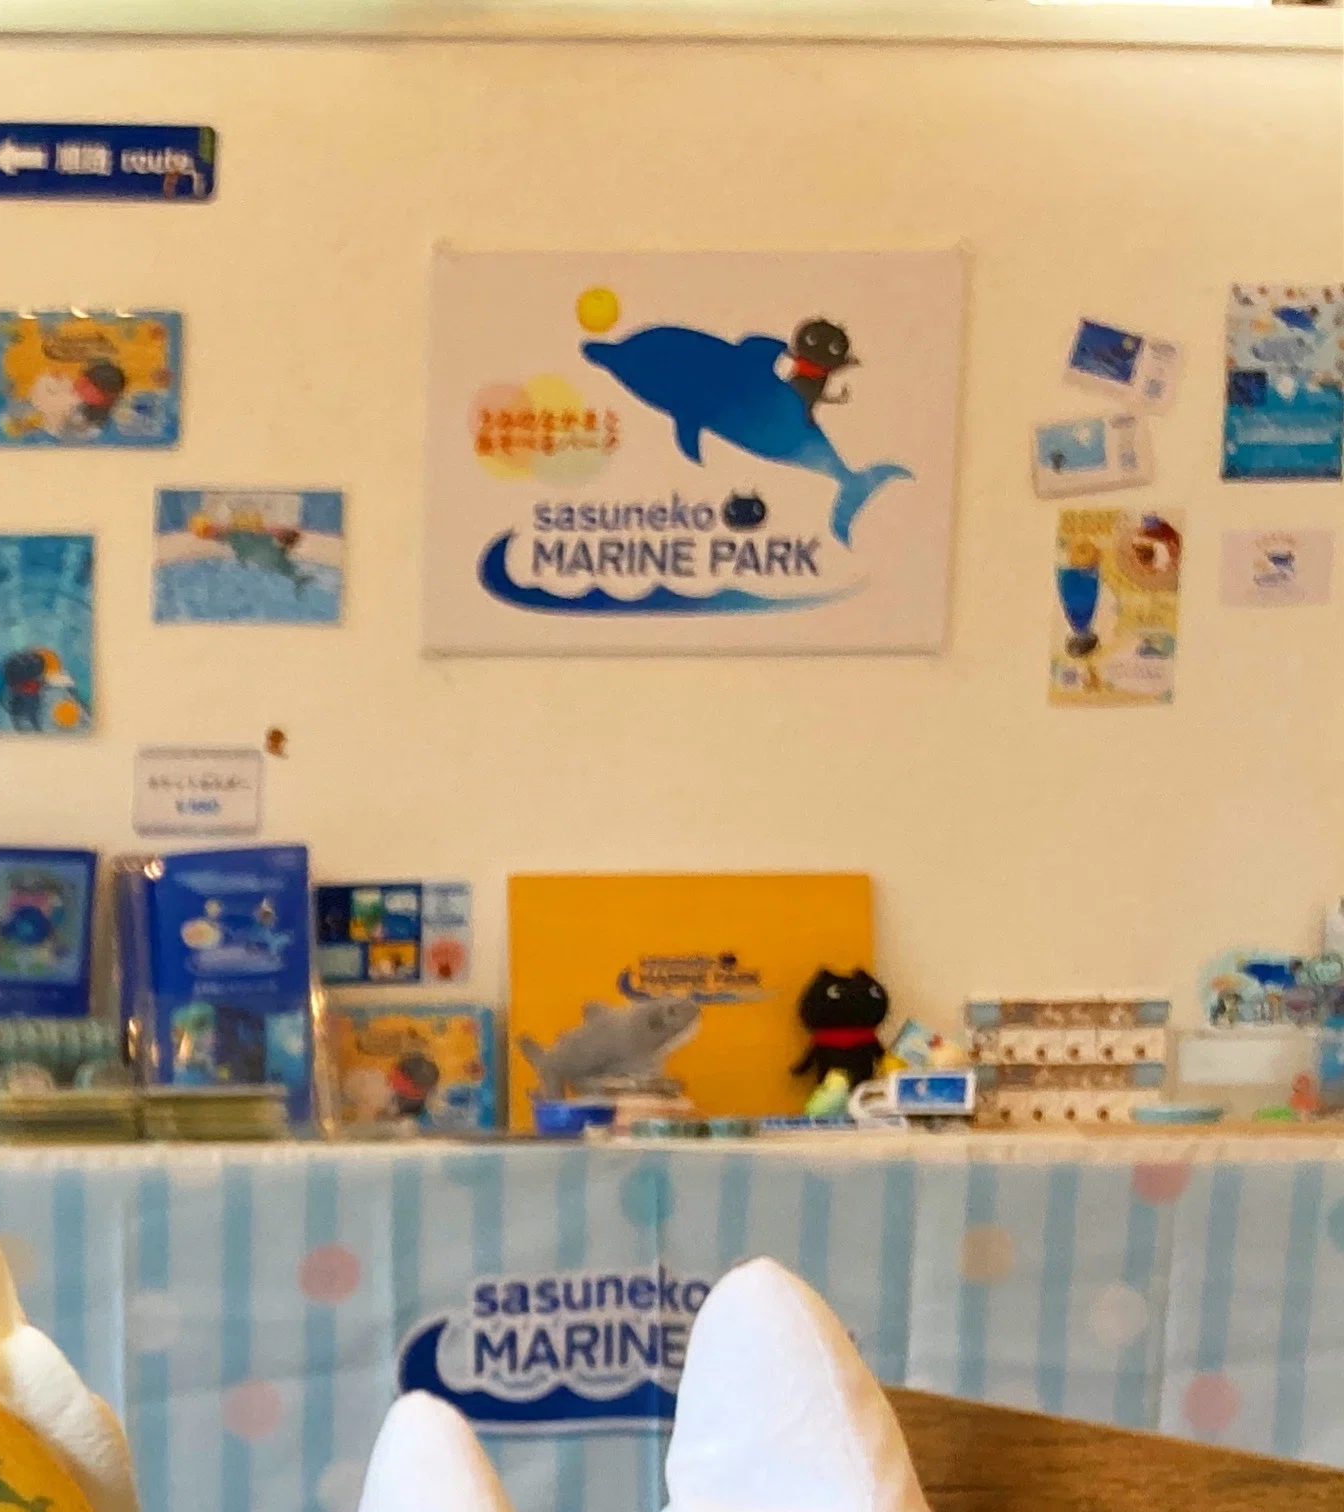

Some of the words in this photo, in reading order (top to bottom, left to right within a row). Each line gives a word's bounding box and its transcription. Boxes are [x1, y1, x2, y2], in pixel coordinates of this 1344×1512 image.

[532, 490, 714, 532] sasuneko
[531, 536, 696, 577] MARINE
[709, 535, 823, 577] PARK
[473, 1263, 711, 1316] sasuneko
[473, 1320, 688, 1374] MARINE
